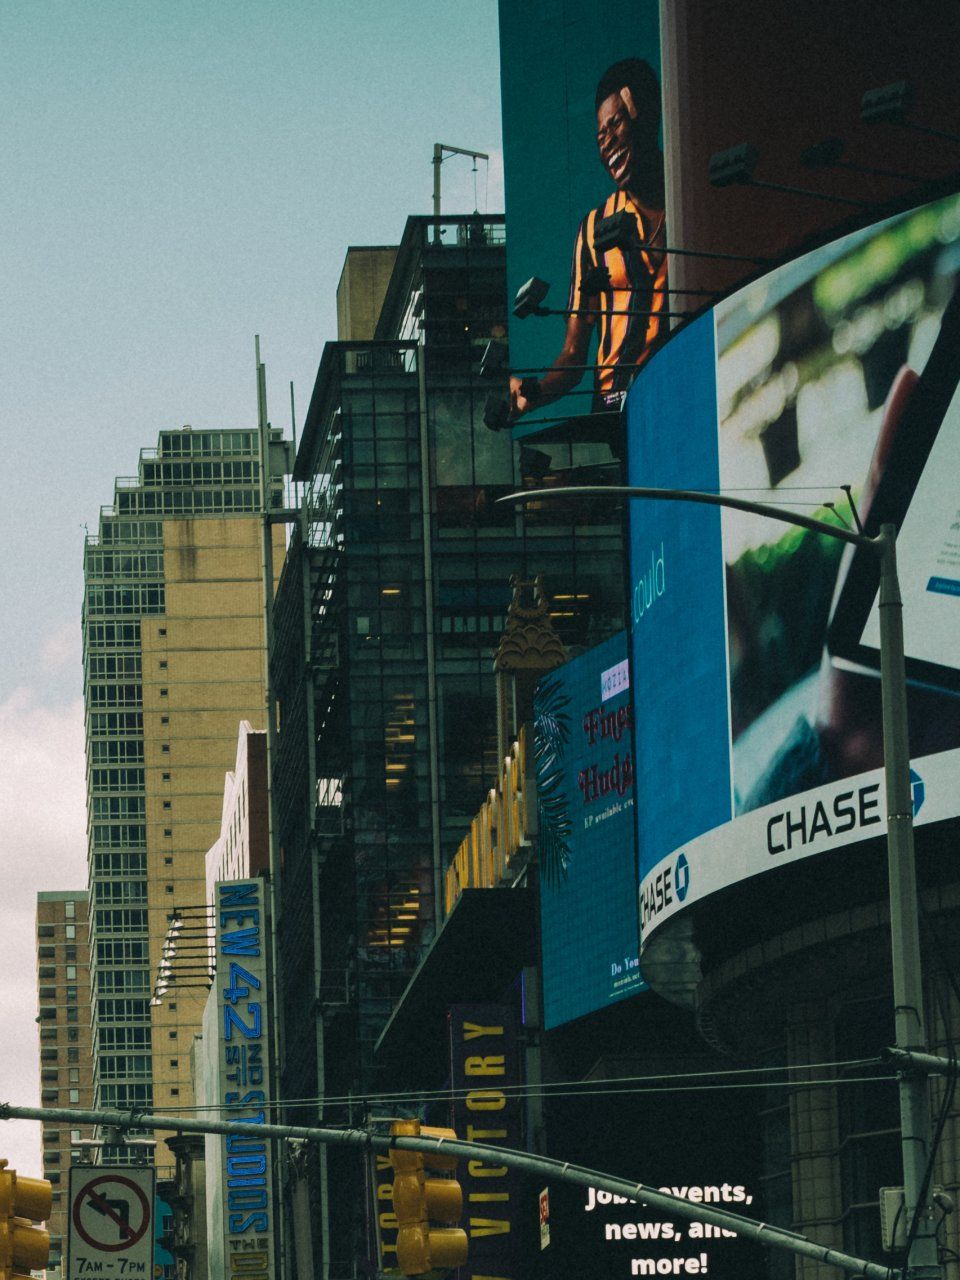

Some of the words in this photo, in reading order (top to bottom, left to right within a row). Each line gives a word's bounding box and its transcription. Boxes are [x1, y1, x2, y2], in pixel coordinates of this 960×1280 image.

[633, 540, 666, 624] could
[766, 782, 882, 856] CHASE
[218, 883, 261, 957] NEW
[221, 961, 263, 1041] 42
[463, 1020, 511, 1239] VICTORY
[76, 1257, 103, 1274] 7AM
[117, 1258, 145, 1274] 7PM
[605, 1221, 682, 1242] news,
[631, 1252, 708, 1276] more!
